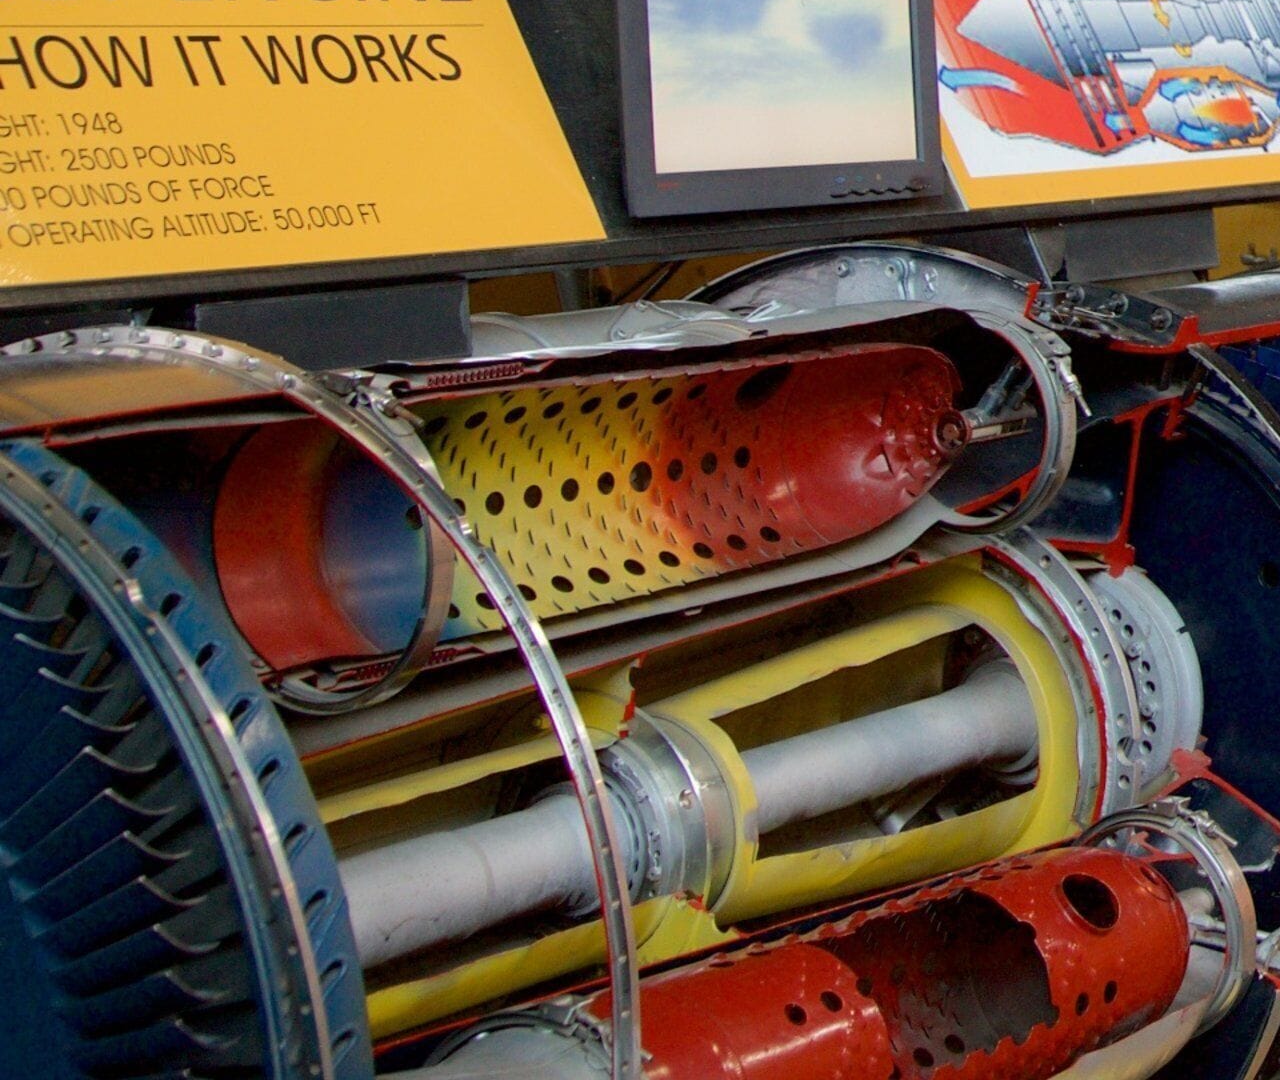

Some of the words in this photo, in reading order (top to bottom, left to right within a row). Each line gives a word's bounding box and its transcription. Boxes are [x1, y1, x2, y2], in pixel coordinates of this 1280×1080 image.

[0, 35, 153, 90] HOW
[173, 35, 228, 87] IT
[241, 33, 462, 85] WORKS
[58, 112, 123, 136] 1948
[61, 146, 128, 172] 2500
[132, 142, 236, 170] POUNDS
[32, 181, 142, 210] POUNDS
[147, 179, 183, 203] OF
[189, 174, 275, 202] FORCE
[7, 216, 154, 248] OPERATING
[162, 210, 269, 238] ALTITUDE:
[272, 204, 353, 232] 50,000
[357, 203, 381, 226] FT
